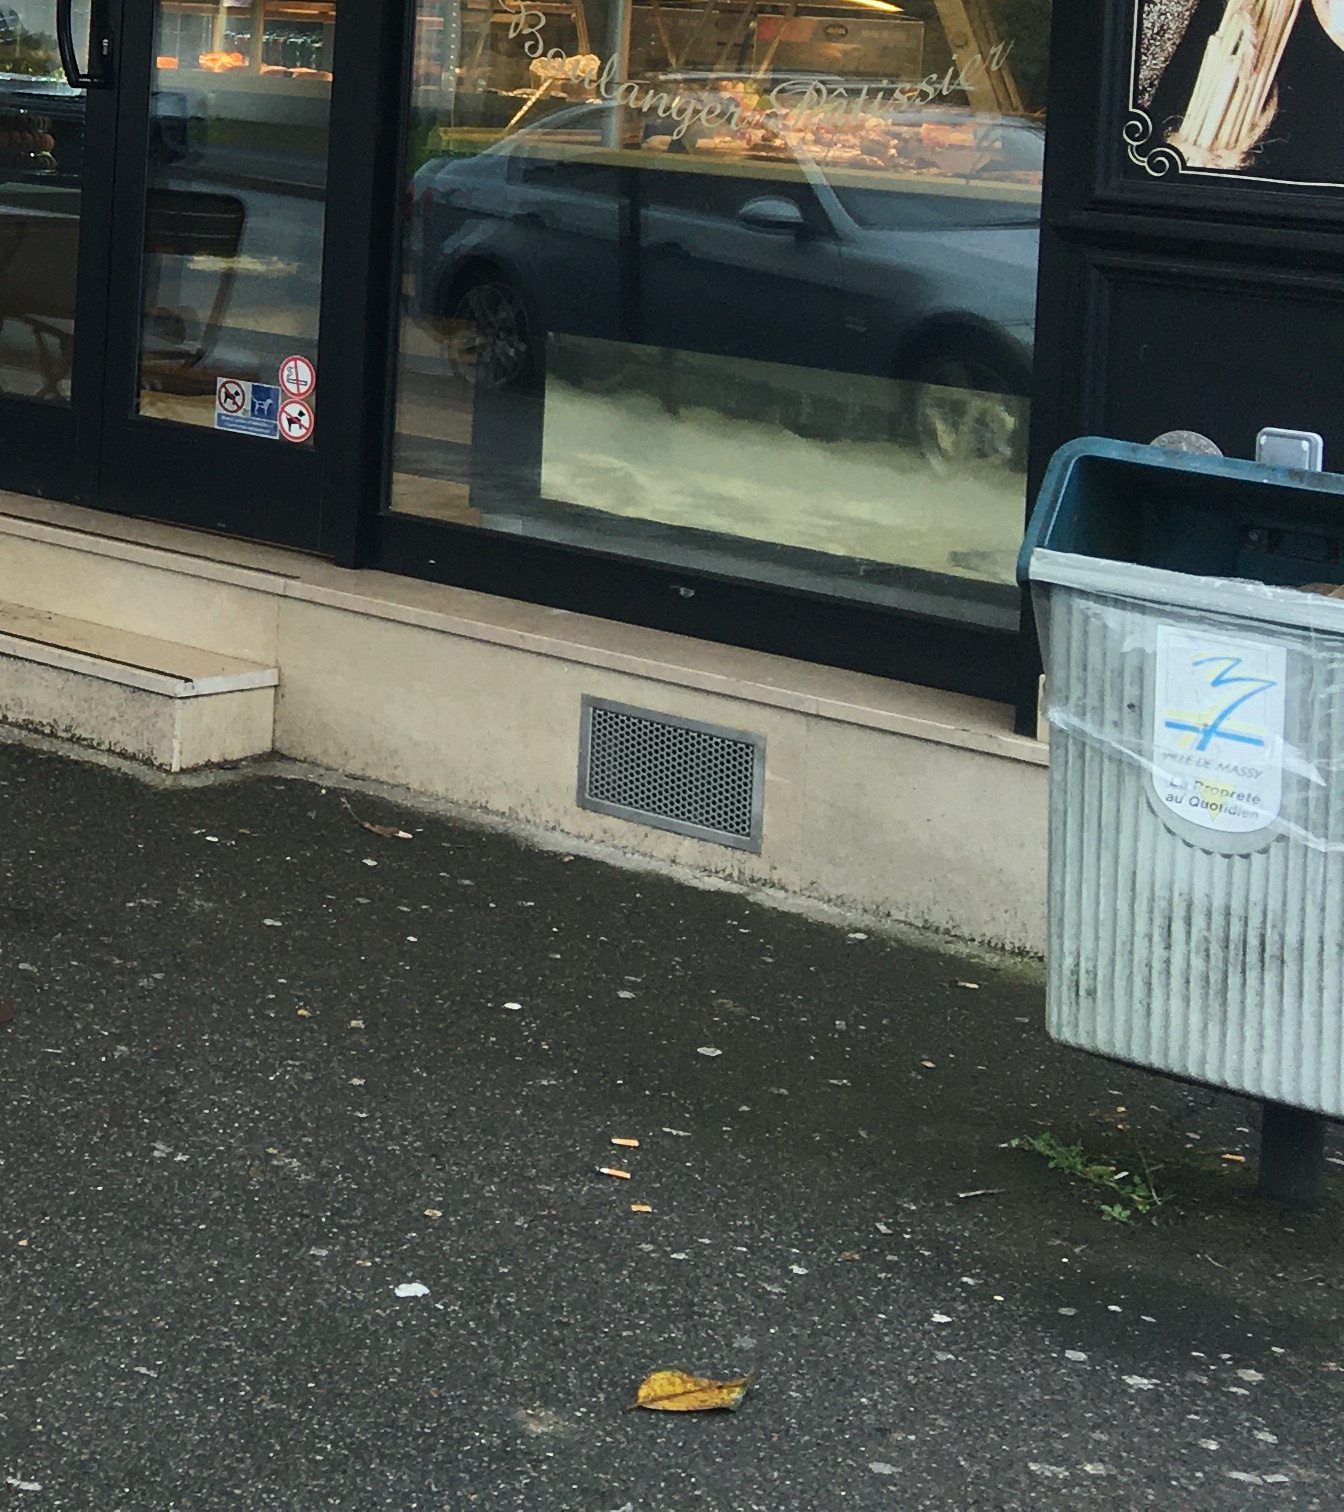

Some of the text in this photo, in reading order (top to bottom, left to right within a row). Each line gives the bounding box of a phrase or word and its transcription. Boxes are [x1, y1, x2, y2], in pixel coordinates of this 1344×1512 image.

[769, 38, 1016, 133] Pâtissier
[1196, 756, 1212, 770] DE
[1215, 761, 1264, 779] MASSY
[1193, 779, 1262, 805] Propreté
[1165, 792, 1260, 820] au Quotidien
